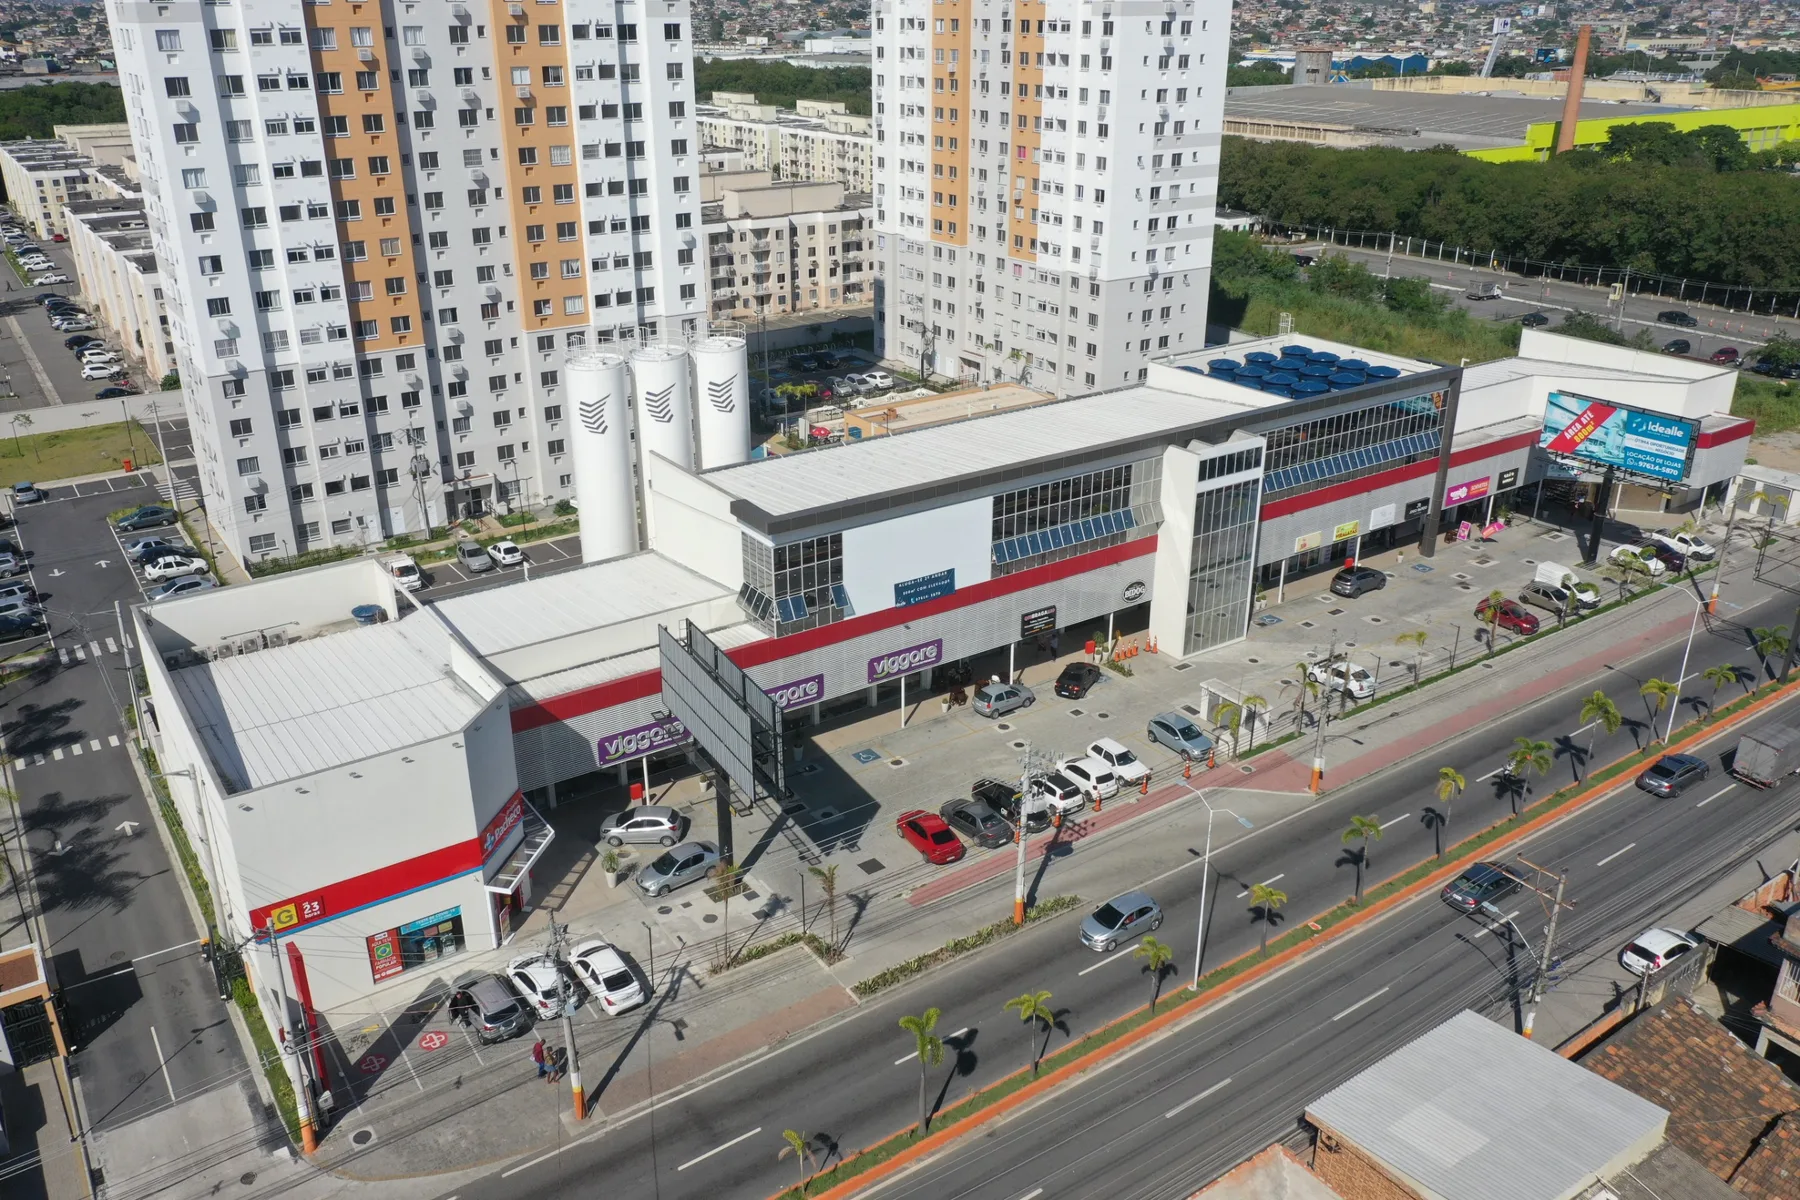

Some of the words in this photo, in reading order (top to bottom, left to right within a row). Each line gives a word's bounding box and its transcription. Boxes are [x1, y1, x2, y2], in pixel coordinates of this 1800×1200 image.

[1626, 450, 1655, 462] LOCAÇÃO
[1663, 459, 1681, 469] LOJAS
[1638, 460, 1679, 476] 97614-5870
[874, 644, 937, 678] viggore
[605, 721, 685, 760] viggore
[495, 805, 520, 840] Pacheco
[277, 909, 294, 925] G
[303, 901, 320, 915] 23
